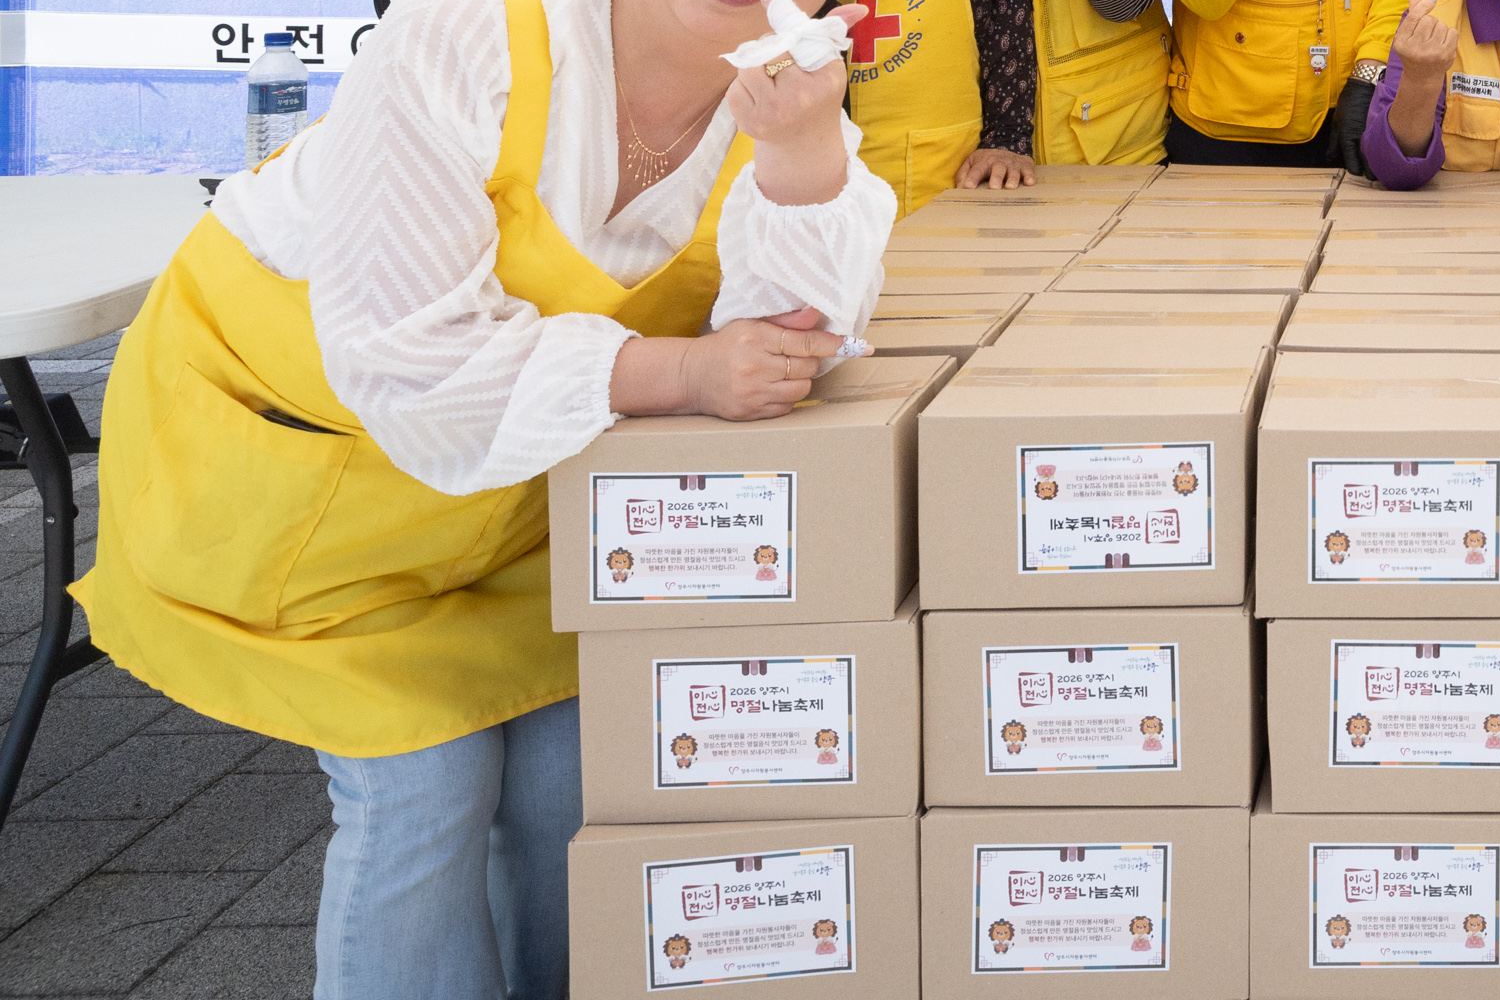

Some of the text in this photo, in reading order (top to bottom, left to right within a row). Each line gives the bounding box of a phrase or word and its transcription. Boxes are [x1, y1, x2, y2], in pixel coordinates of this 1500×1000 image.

[850, 32, 923, 83] RED CROSS
[1410, 487, 1439, 495] 양주시
[668, 502, 727, 510] 2026 양주시
[1382, 499, 1472, 512] 명절나눔축제
[668, 514, 762, 528] 명절나눔축제
[1050, 515, 1140, 530] 명절나눔축제
[1083, 533, 1112, 542] 양주시
[1085, 674, 1114, 682] 양주시
[1432, 670, 1460, 679] 양주시
[730, 686, 789, 695] 2026 양주시
[1058, 685, 1147, 700] 명절나눔축제
[1404, 682, 1493, 696] 명절나눔축제
[730, 698, 823, 713] 명절나눔축제
[1076, 873, 1105, 882] 양주시
[1411, 872, 1439, 880] 양주시
[724, 880, 785, 893] 2026 양주시
[1048, 885, 1138, 899] 명절나눔축제
[1383, 884, 1472, 897] 명절나눔축제
[724, 889, 820, 911] 명절나눔축제
